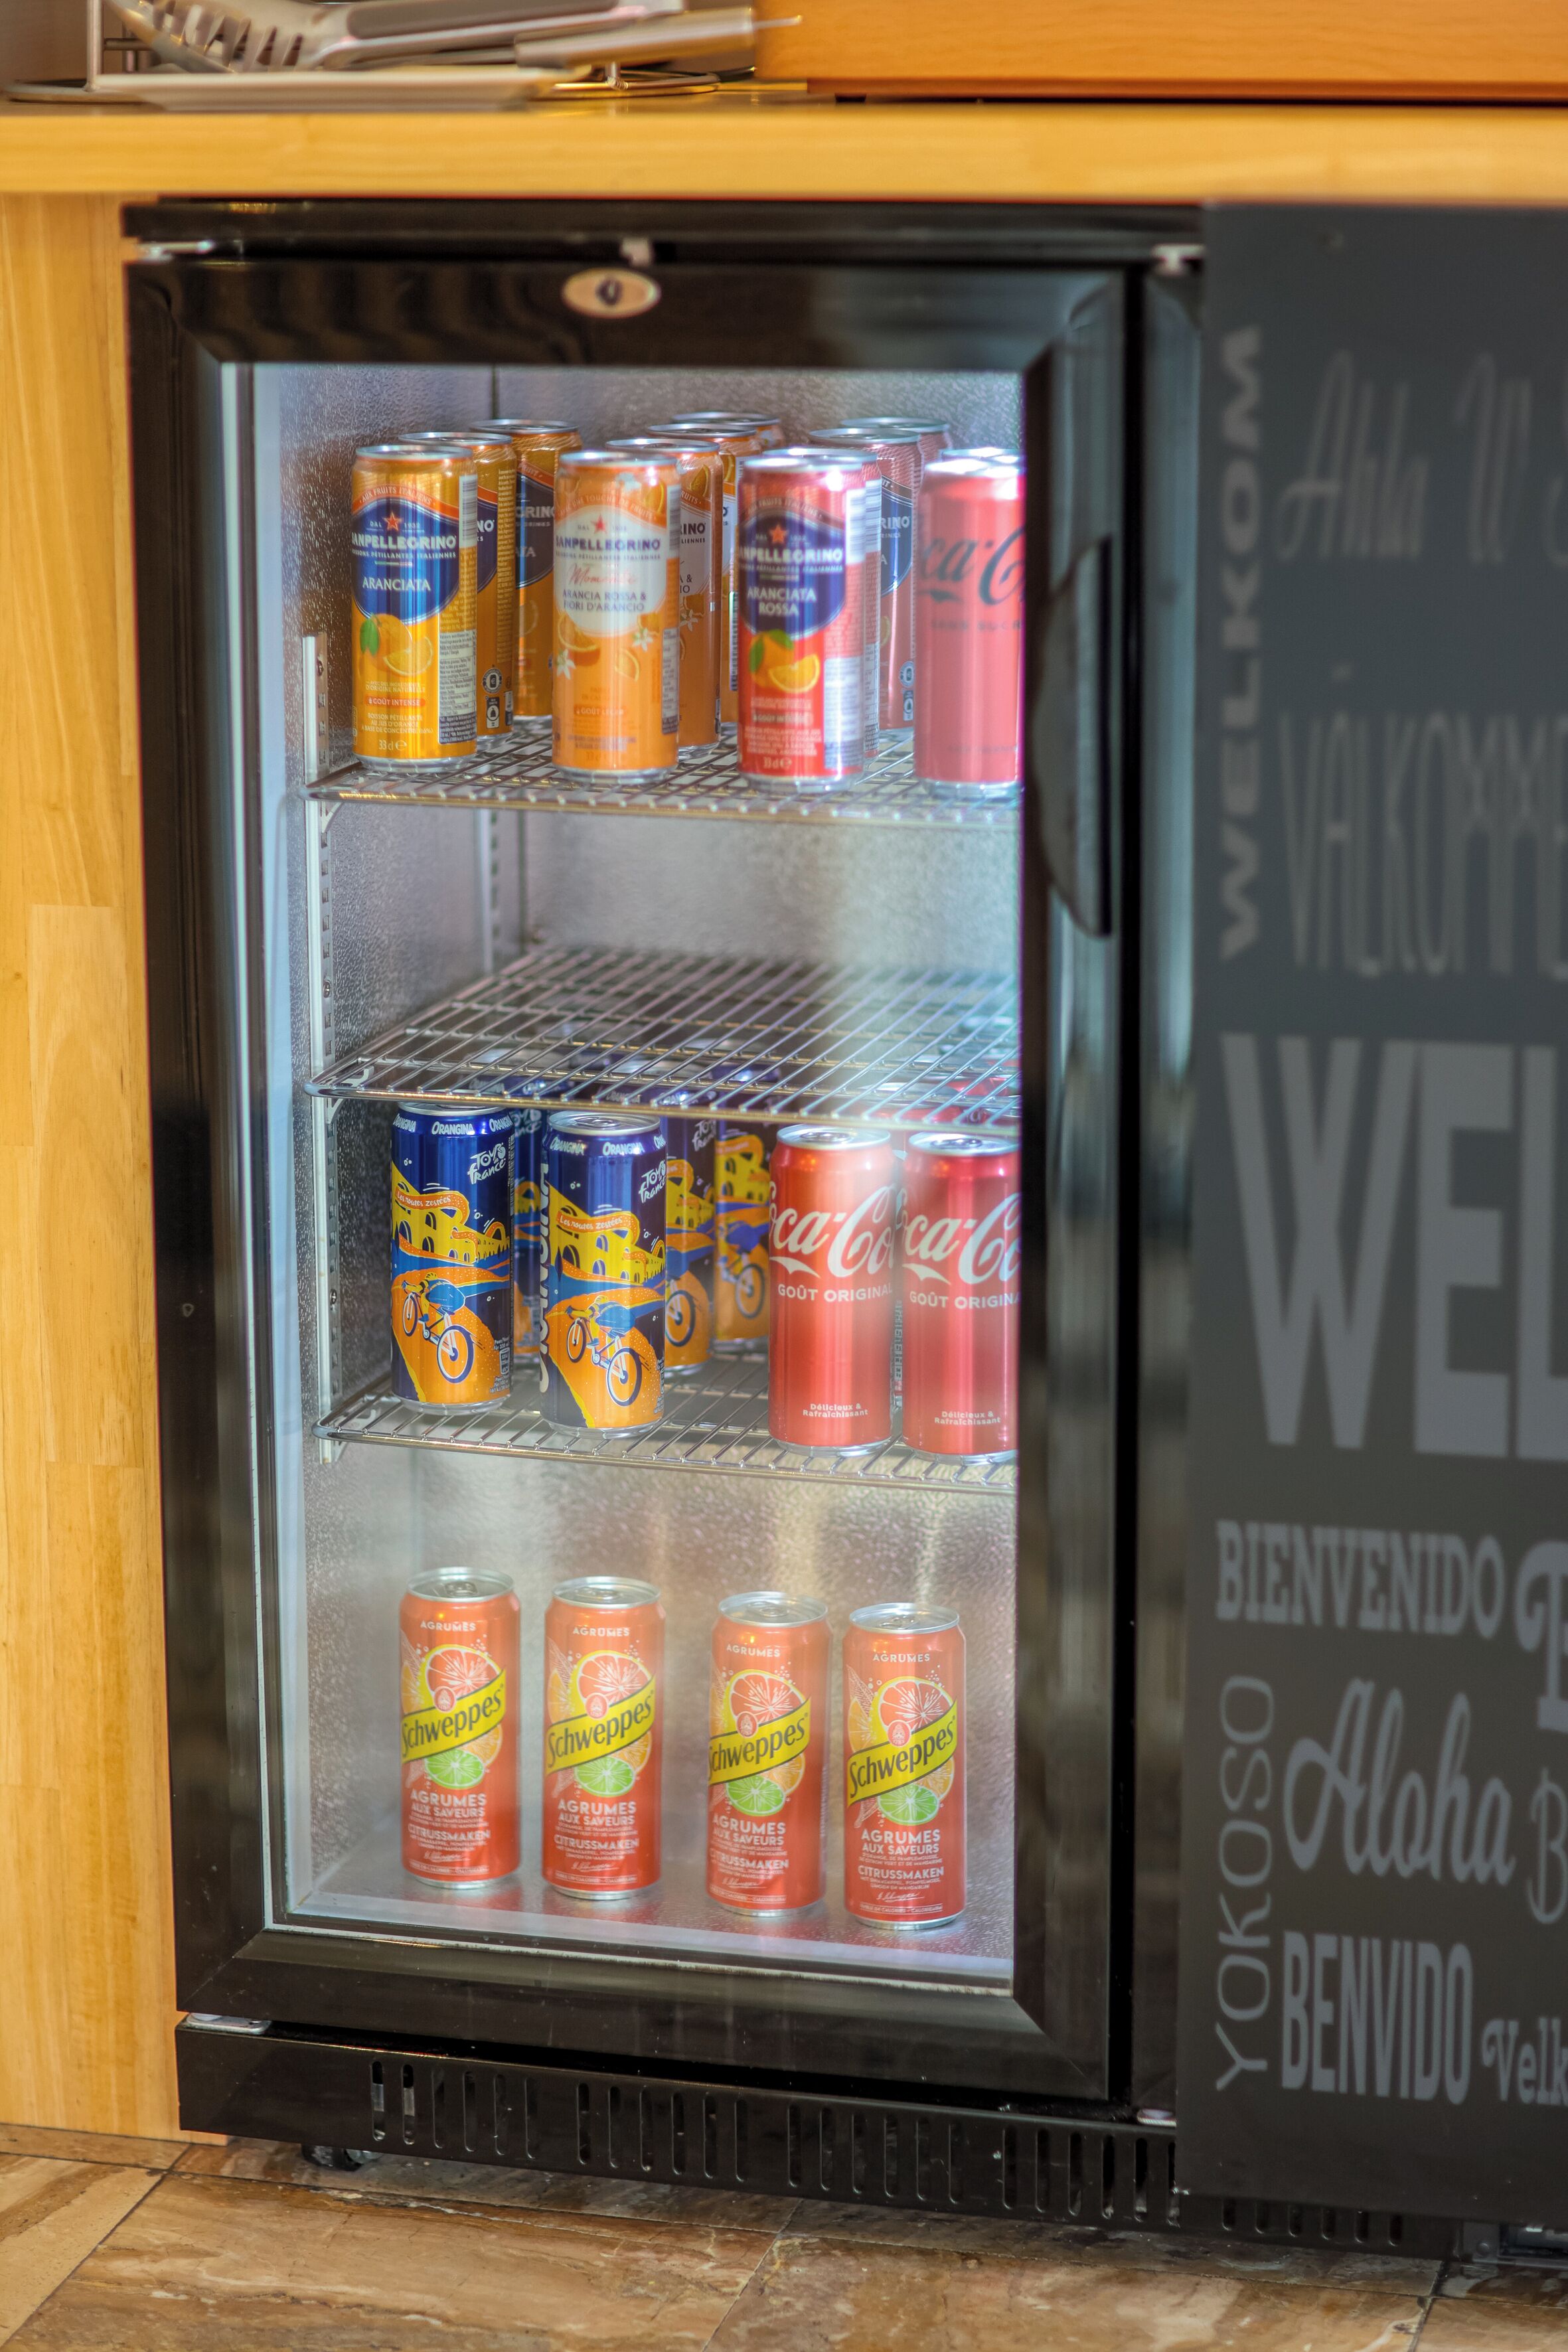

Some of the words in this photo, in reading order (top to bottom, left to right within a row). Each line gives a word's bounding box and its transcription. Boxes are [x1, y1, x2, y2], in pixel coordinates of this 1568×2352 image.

[373, 486, 396, 495] FRUITS
[680, 490, 698, 505] RUITS
[740, 546, 844, 563] ANPELLEGRINO
[362, 577, 431, 591] ARANCIATA
[563, 589, 600, 600] ARANCIA
[747, 587, 817, 603] ARANCIATA
[564, 600, 584, 611] FIORI
[587, 602, 645, 612] D'ARANCIO
[758, 601, 799, 616] ROSSA
[1220, 324, 1261, 961] WELKOM
[378, 740, 387, 750] 33
[431, 1121, 475, 1135] ORANGINA
[489, 1115, 513, 1133] ORANGIN
[550, 1136, 585, 1156] ORANGINA
[603, 1142, 645, 1156] ORANGINA
[405, 1196, 424, 1207] routes
[426, 1196, 451, 1207] zestées
[560, 1215, 570, 1227] Les
[572, 1220, 594, 1229] routes
[595, 1217, 623, 1229] zestées
[1220, 1032, 1568, 1462] WEL
[778, 1284, 818, 1301] GOÛT
[824, 1283, 893, 1302] ORIGINAL
[909, 1290, 948, 1307] GOÛT
[803, 1409, 868, 1418] Rafraîchissant
[810, 1403, 853, 1411] Délicieux
[934, 1417, 1001, 1426] Rafraîchissant
[1216, 1519, 1506, 1640] BIENVENIDO
[420, 1620, 477, 1631] AGRUMES
[573, 1627, 631, 1637] AGRUMES
[726, 1644, 781, 1658] AGRUMES
[873, 1653, 931, 1663] AGRUMES
[401, 1688, 502, 1758] Schweppes
[548, 1695, 651, 1768] Schweppes
[849, 1721, 954, 1800] Schweppes
[1283, 1677, 1516, 1887] Aloha
[410, 1789, 487, 1807] AGRUMES
[412, 1802, 431, 1815] AUX
[433, 1806, 486, 1818] SAVEURS
[558, 1799, 637, 1816] AGRUMES
[559, 1813, 580, 1825] AUX
[583, 1815, 635, 1826] SAVEURS
[712, 1814, 787, 1835] AGRUMES
[408, 1824, 491, 1841] CITRUSSMAKEN
[733, 1833, 785, 1846] SAVEURS
[861, 1829, 941, 1844] AGRUMES
[554, 1834, 640, 1849] CITRUSSMAKEN
[862, 1842, 884, 1854] AUX
[888, 1843, 940, 1855] SAVEURS
[858, 1865, 945, 1880] CITRUSSMAKEN
[1216, 1675, 1274, 2091] YOKOSO
[1281, 1930, 1473, 2104] BENVIDO
